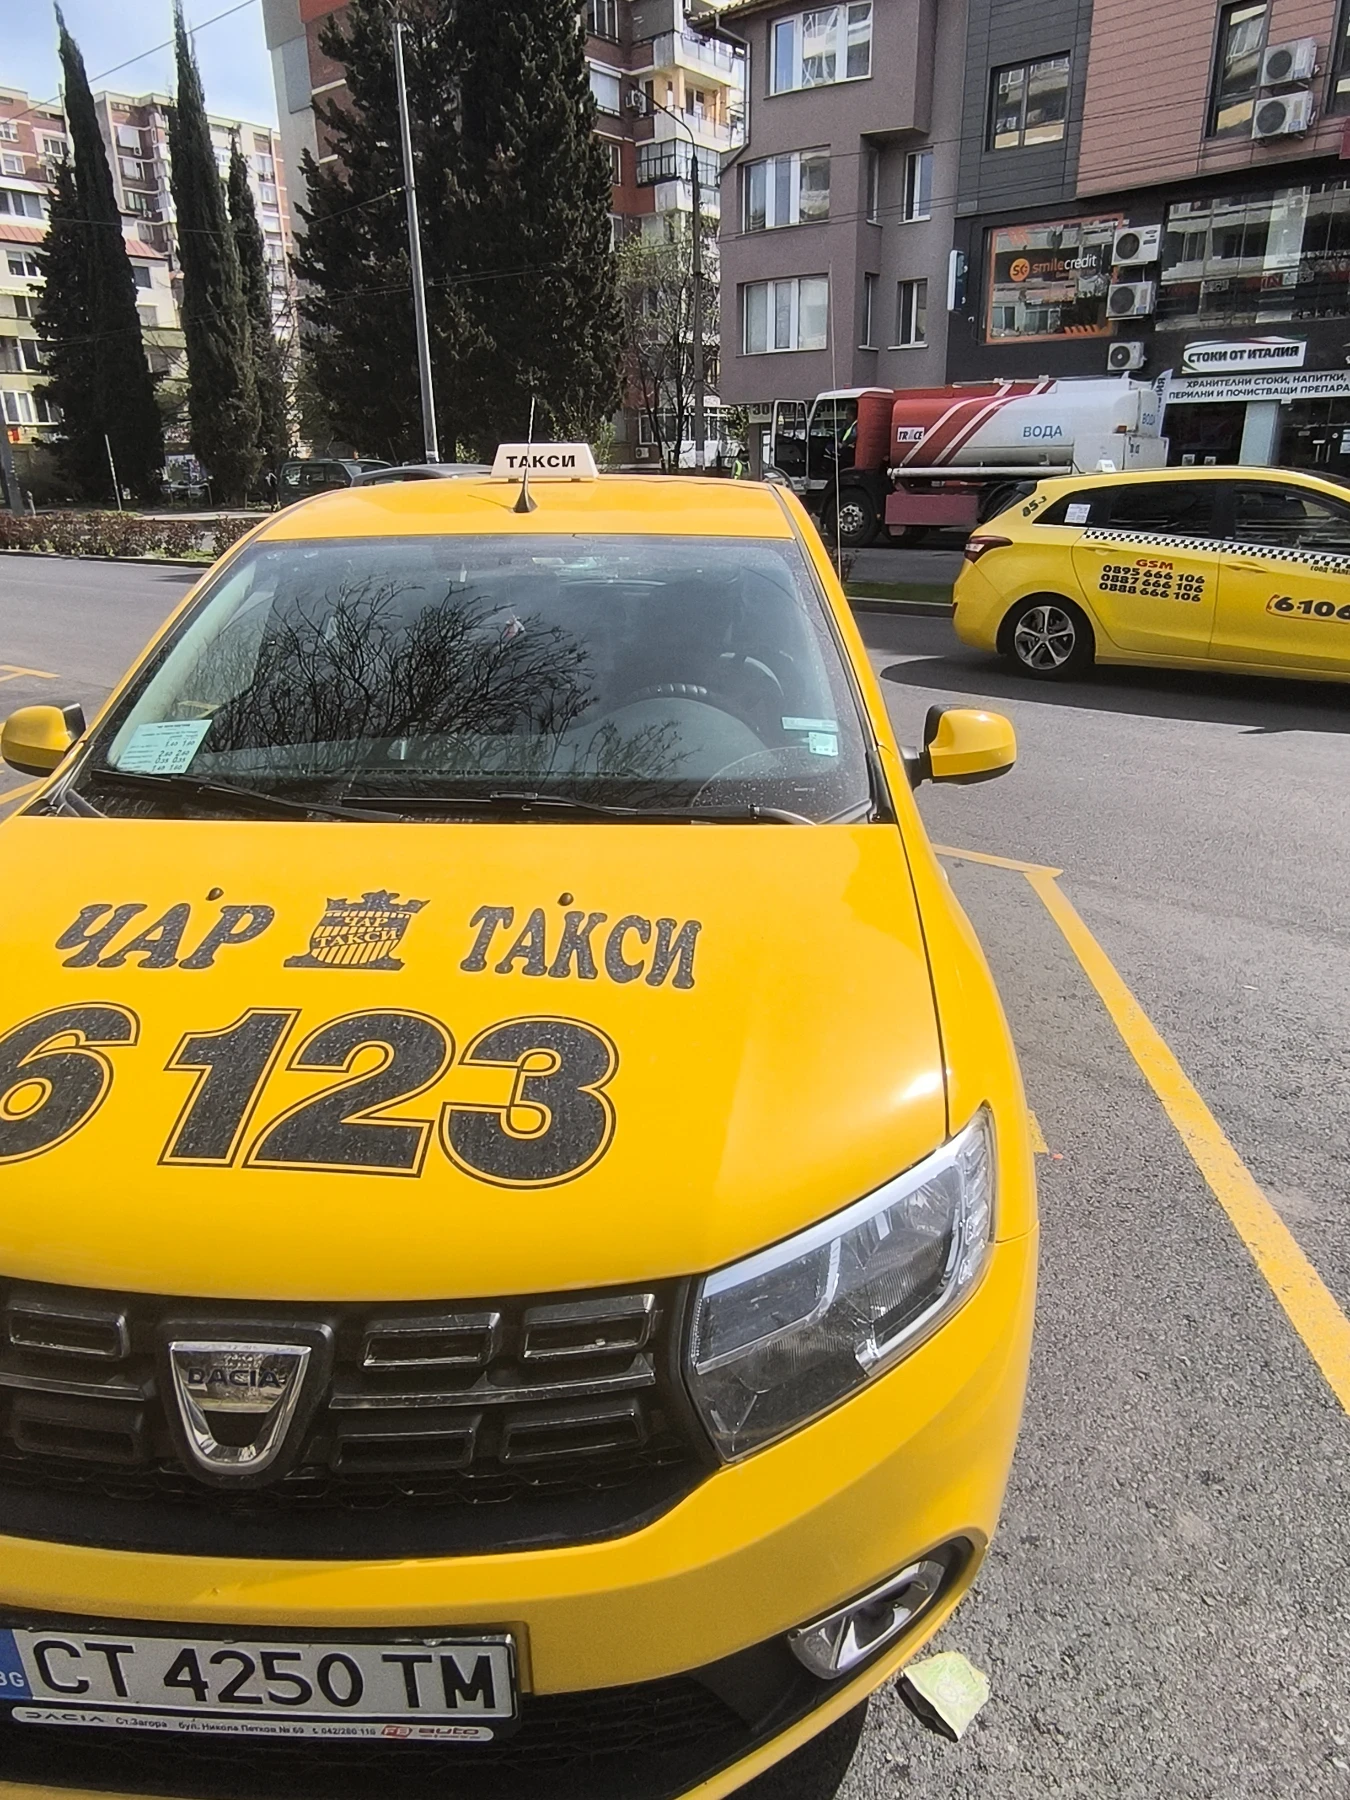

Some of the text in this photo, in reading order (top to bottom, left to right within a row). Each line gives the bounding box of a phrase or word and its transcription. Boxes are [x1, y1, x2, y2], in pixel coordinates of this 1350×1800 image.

[1033, 253, 1097, 273] smilecredit
[1188, 346, 1299, 363] СТОКИ ОТ ИТАЛИЯ
[1186, 373, 1346, 388] ХРАНИТЕЛНИ СТОКИ, НАПИТКИ,
[1169, 391, 1214, 400] ПЕРИЛНИ
[1216, 390, 1223, 398] И
[1226, 386, 1298, 398] ПОЧИСТВАЩИ
[1022, 425, 1063, 440] ВОДА
[506, 454, 576, 469] ТАКСИ
[1135, 559, 1174, 570] GSM
[1102, 564, 1206, 584] 0895 666 106
[1100, 573, 1204, 593] 0887 666 106
[1098, 582, 1202, 602] 0888 666 106
[344, 917, 389, 927] ЧАР
[53, 903, 702, 990] ЧАР ТАКСИ
[316, 930, 398, 948] ТАКСИ
[188, 1368, 281, 1388] DACIA
[163, 1648, 364, 1708] 4250
[25, 1711, 104, 1723] DACIA
[419, 1727, 480, 1736] auto
